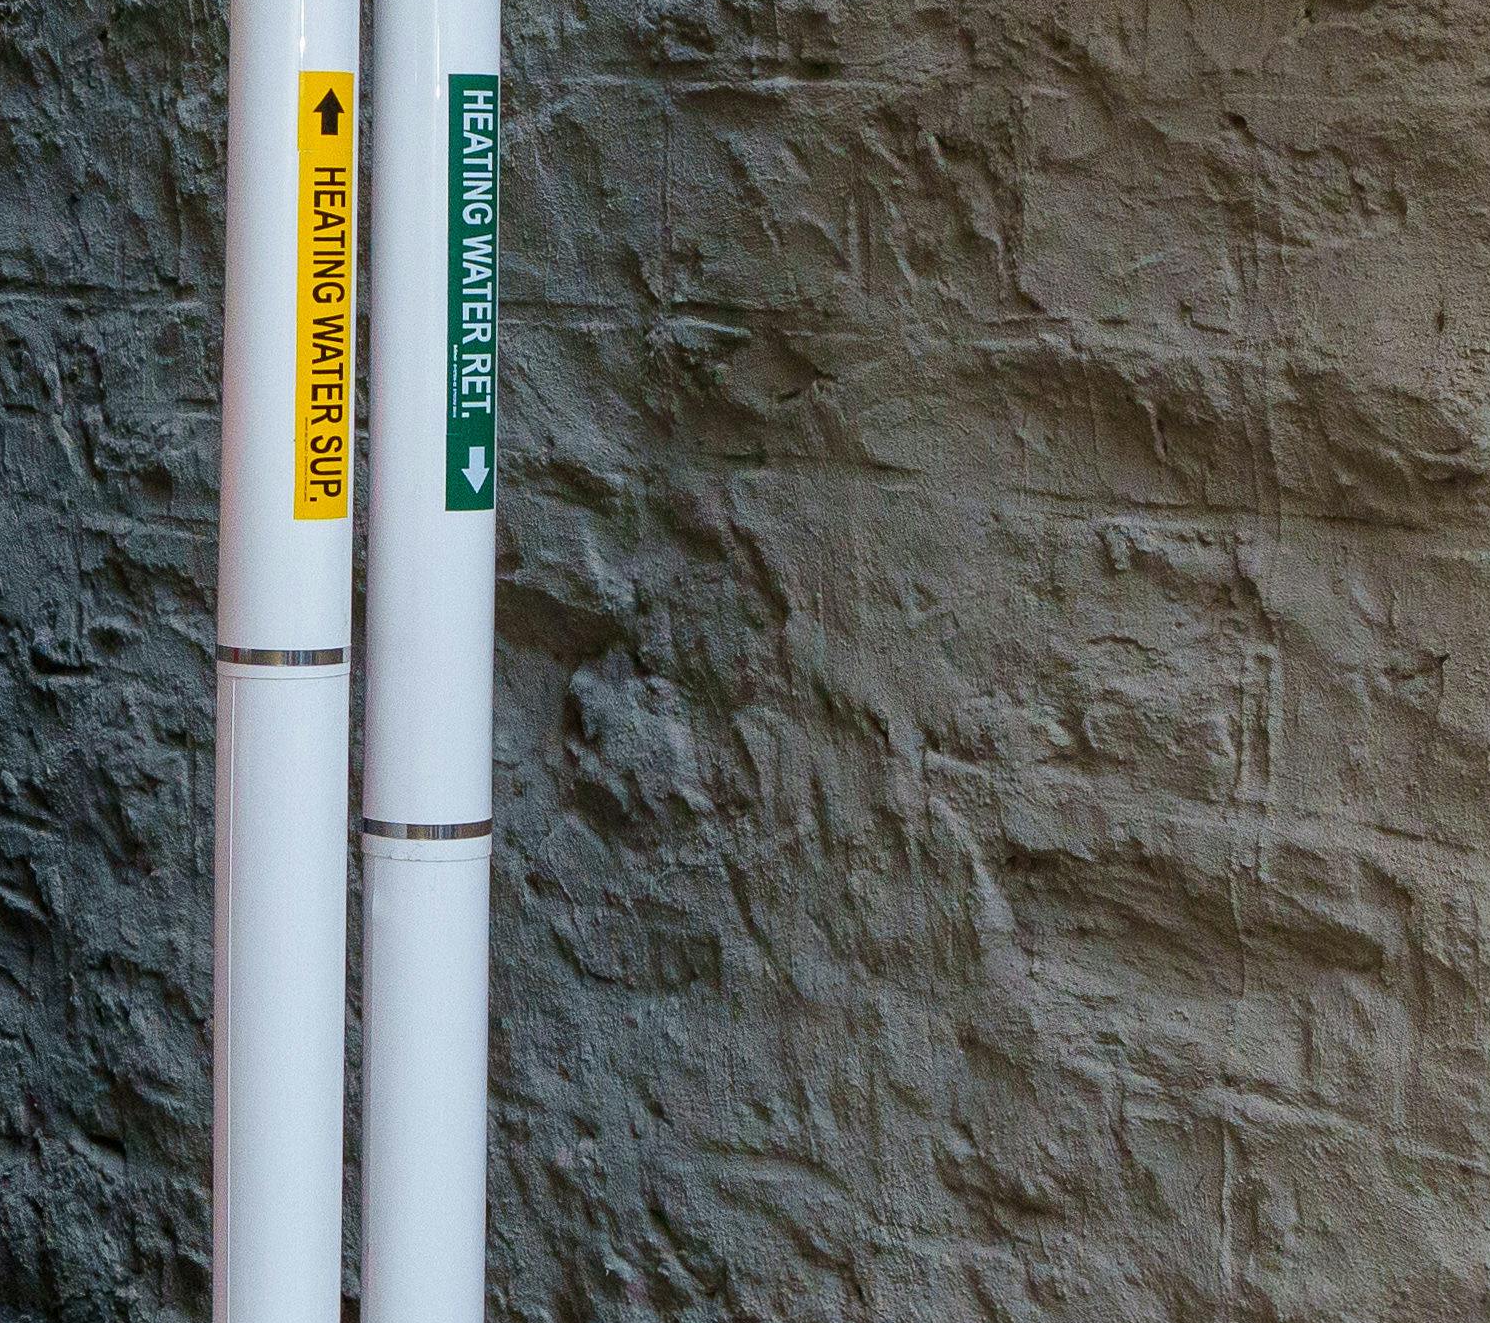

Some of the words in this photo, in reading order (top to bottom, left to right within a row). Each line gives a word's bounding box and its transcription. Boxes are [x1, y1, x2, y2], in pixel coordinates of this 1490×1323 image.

[462, 89, 494, 225] HEATING
[312, 167, 347, 303] HEATING
[462, 233, 493, 345] WATER
[311, 313, 345, 426] WATER
[461, 353, 492, 418] RET.
[309, 434, 343, 502] SUP.
